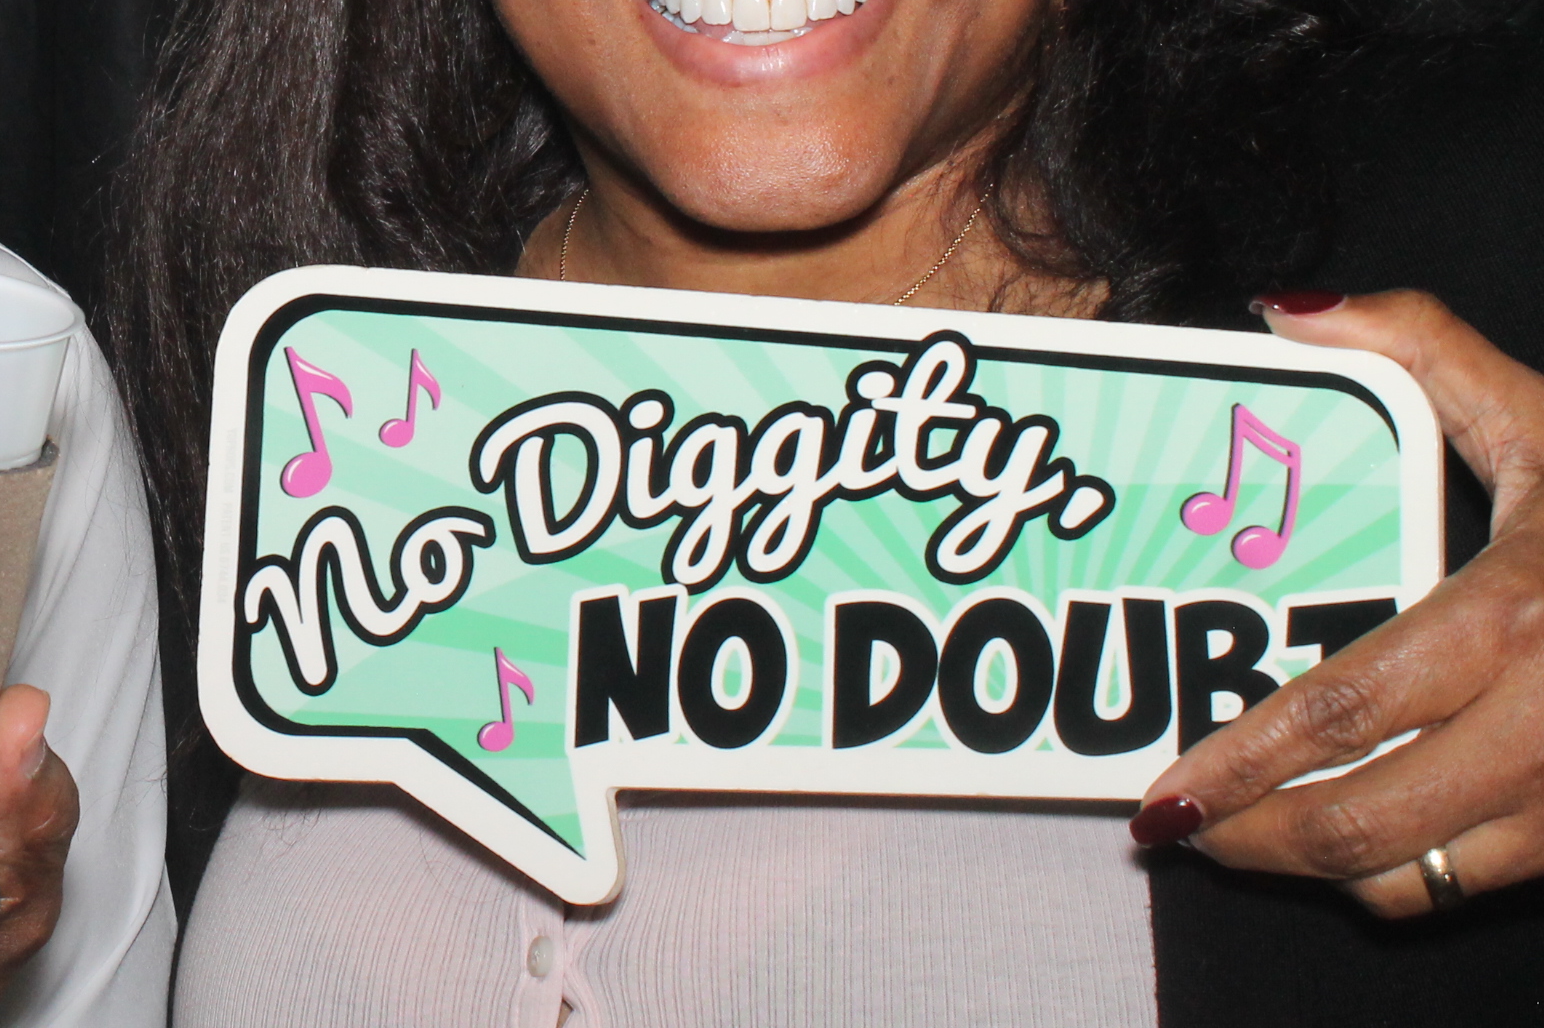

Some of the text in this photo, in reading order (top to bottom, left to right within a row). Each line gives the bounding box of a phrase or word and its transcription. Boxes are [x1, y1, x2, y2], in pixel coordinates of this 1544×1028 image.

[241, 334, 1113, 692] No Diggity,
[574, 595, 789, 751] NO
